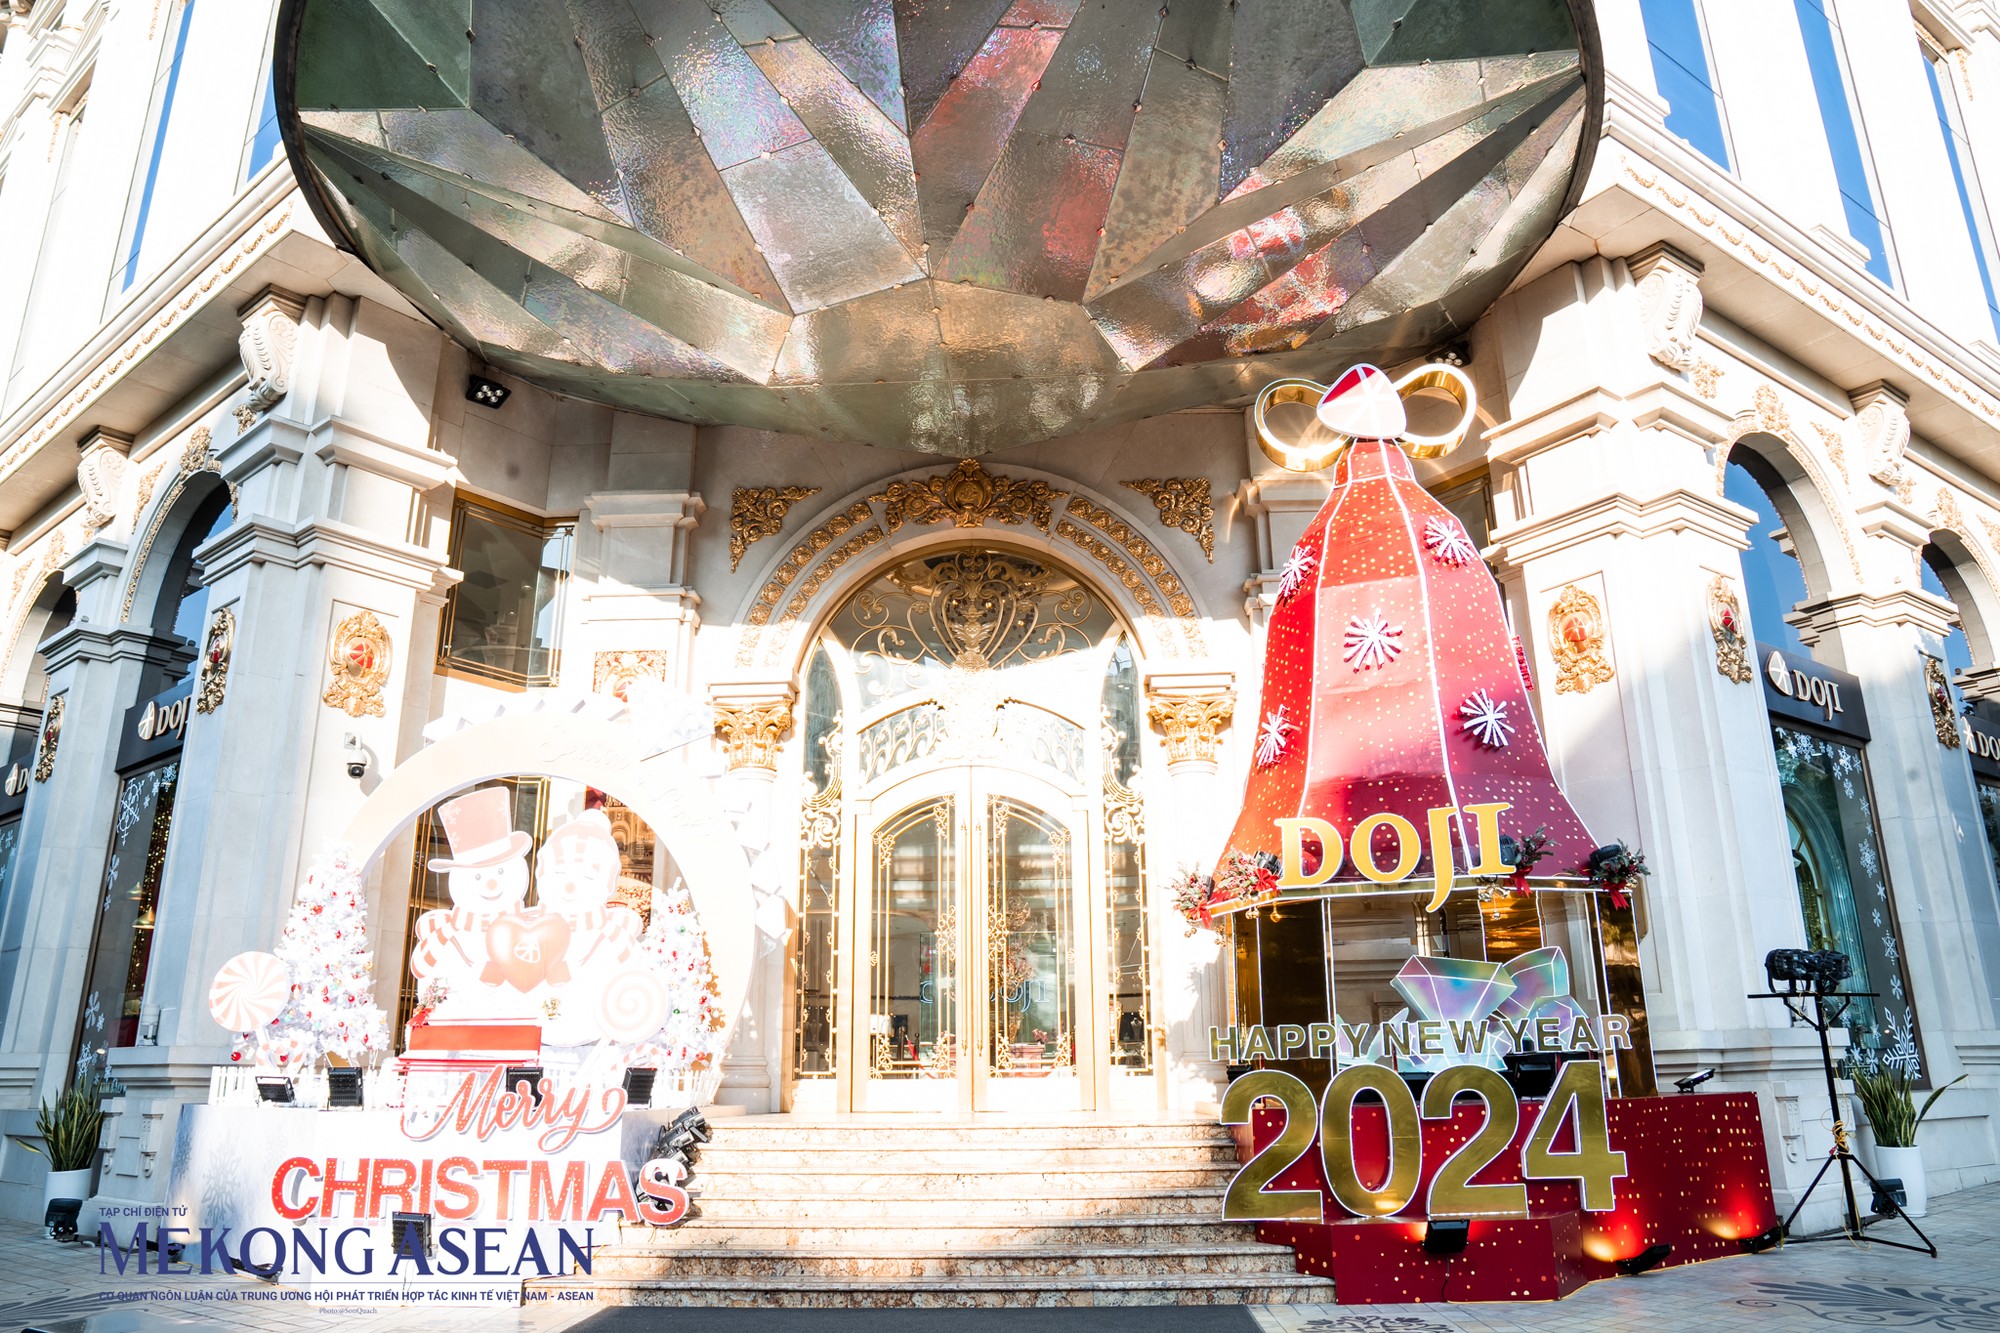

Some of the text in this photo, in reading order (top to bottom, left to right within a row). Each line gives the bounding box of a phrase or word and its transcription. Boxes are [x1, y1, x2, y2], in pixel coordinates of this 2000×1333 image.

[155, 695, 192, 740] DOJ
[1792, 669, 1844, 721] DOJI
[1976, 730, 2000, 761] DO
[1273, 802, 1517, 913] DOJI
[1207, 1013, 1633, 1063] HAPPY NEW YEAR
[400, 1065, 627, 1154] Merry
[1219, 1060, 1628, 1222] 2024
[270, 1156, 691, 1226] CHRISTMAS
